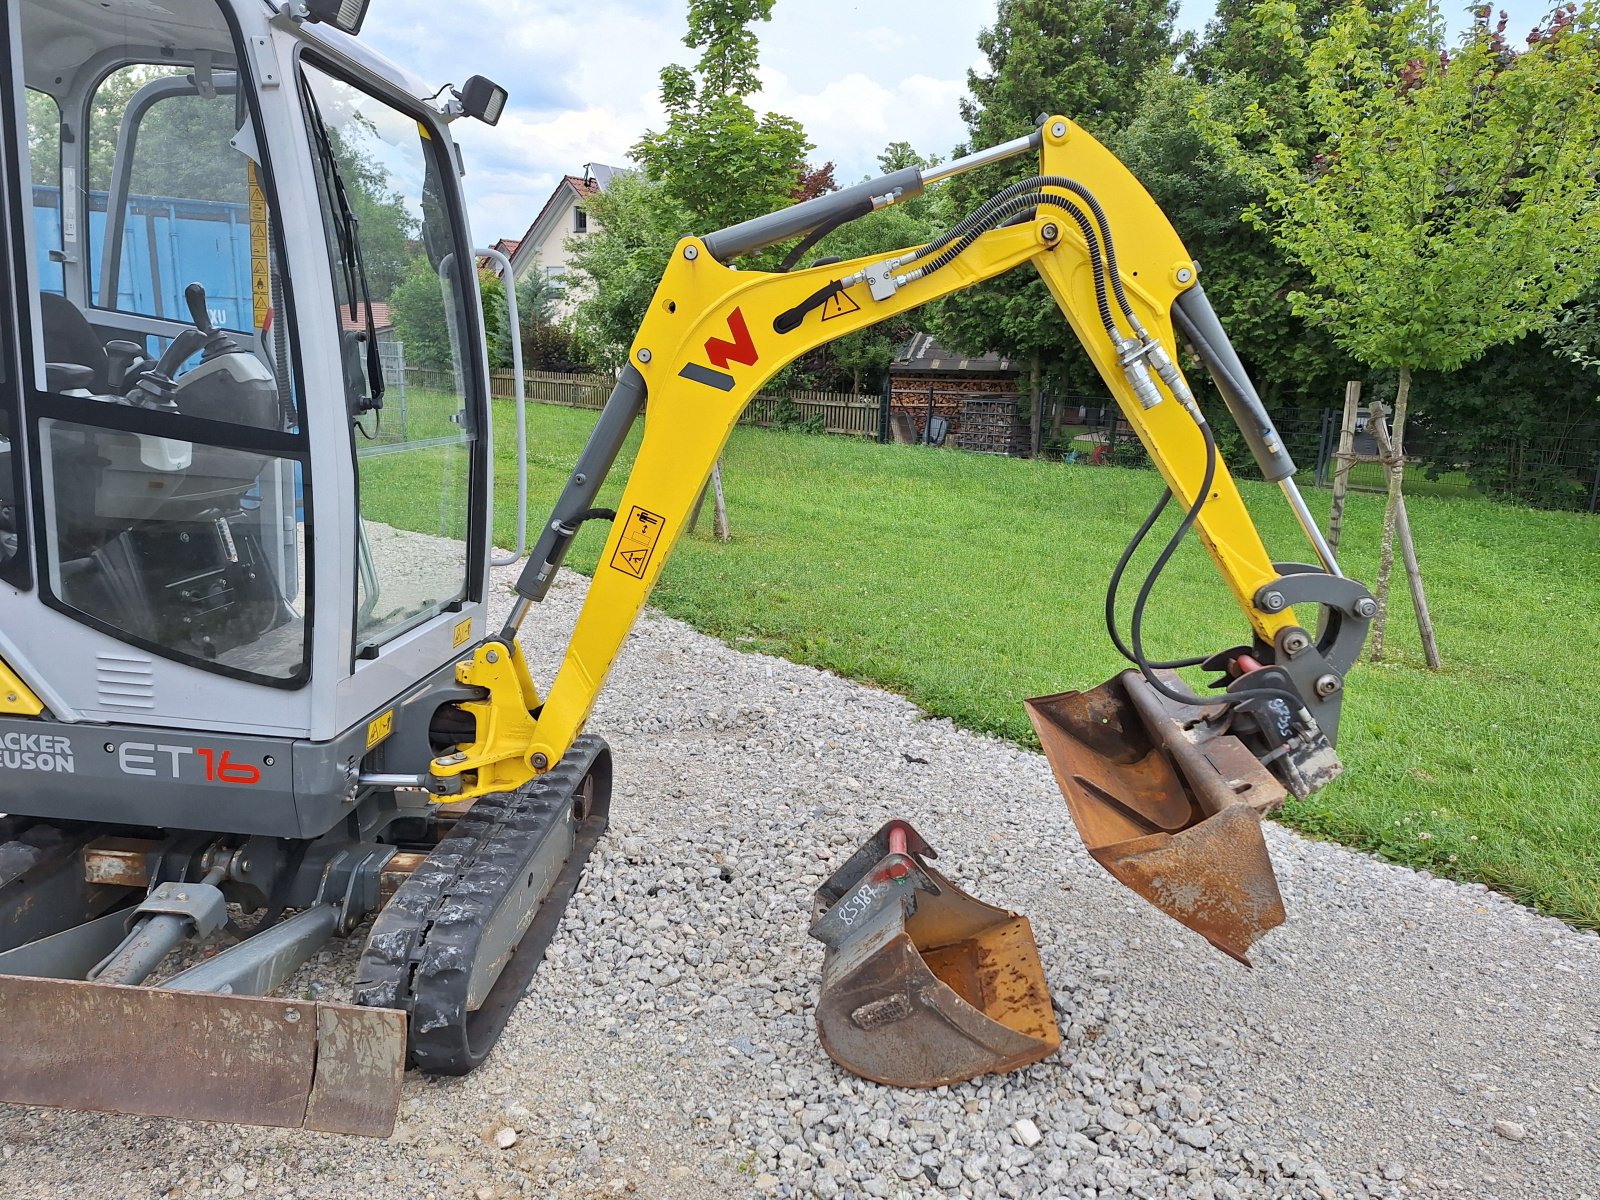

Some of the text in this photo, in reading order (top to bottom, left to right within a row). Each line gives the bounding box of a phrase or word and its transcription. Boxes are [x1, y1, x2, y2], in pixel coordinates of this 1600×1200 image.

[0, 750, 75, 773] USON
[118, 741, 261, 785] ET16
[838, 884, 877, 926] 85987
